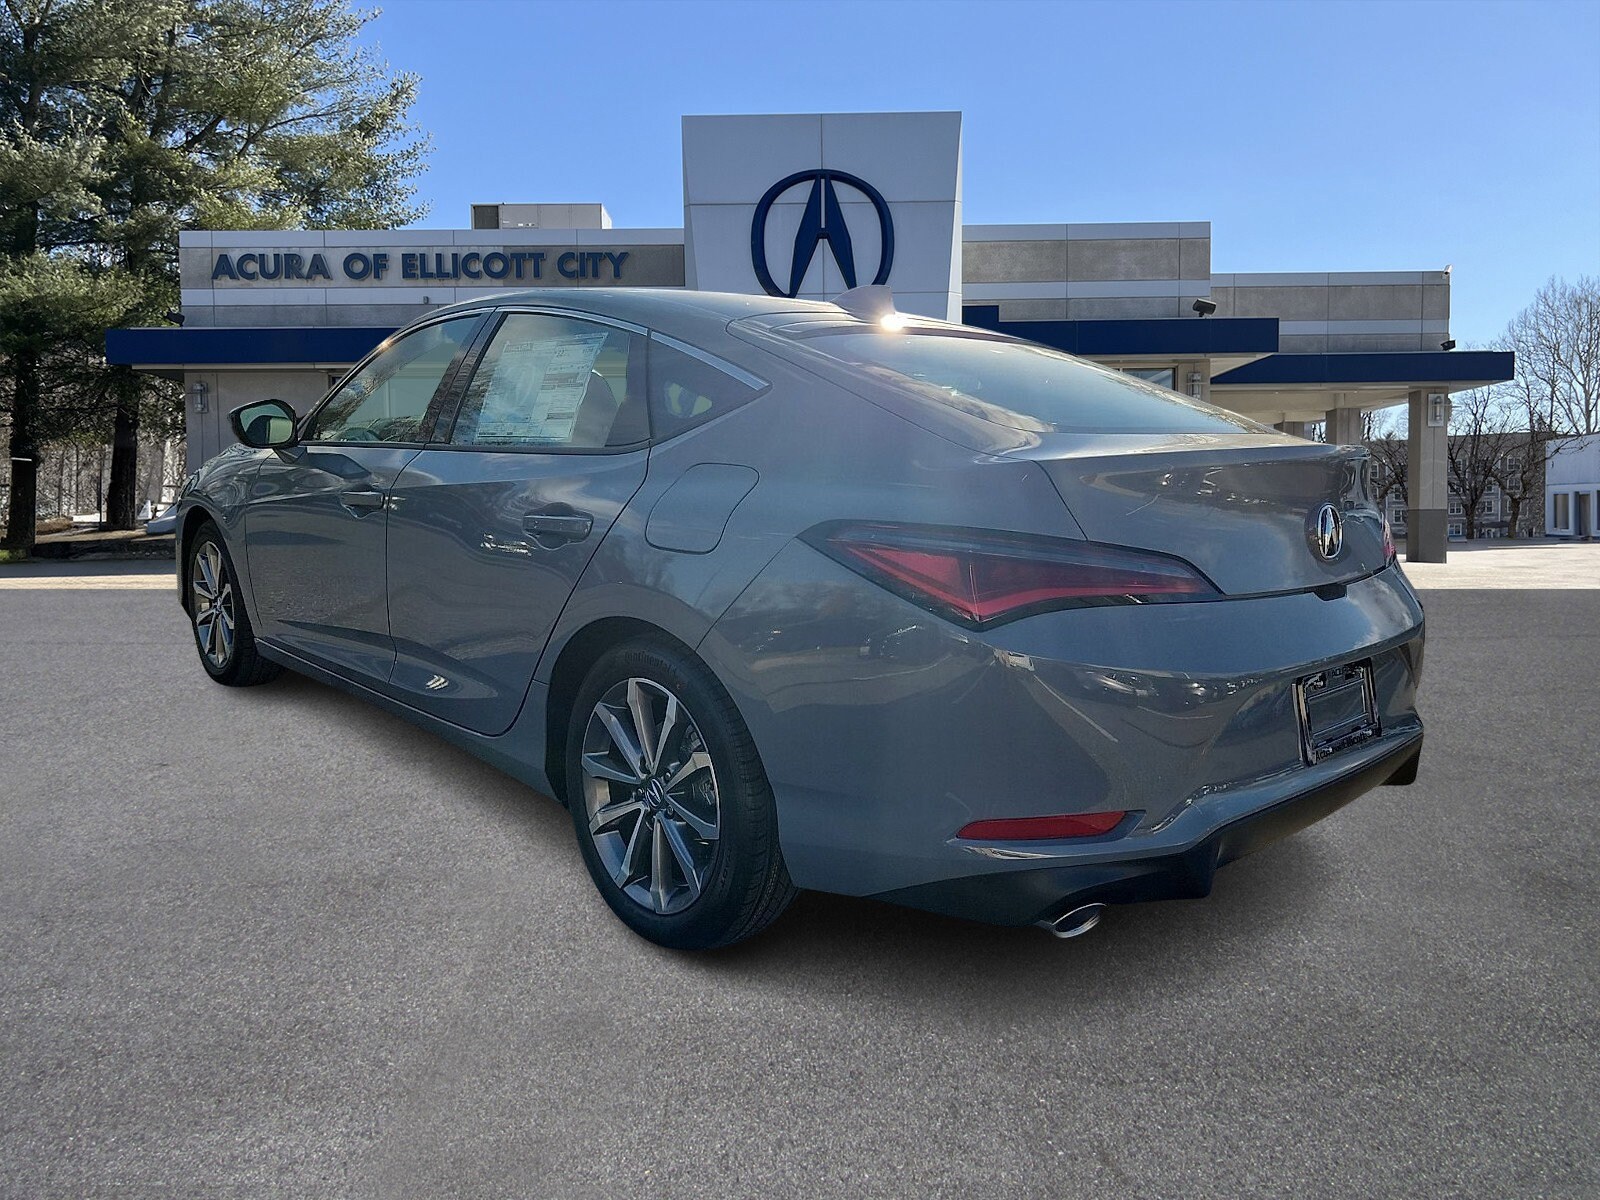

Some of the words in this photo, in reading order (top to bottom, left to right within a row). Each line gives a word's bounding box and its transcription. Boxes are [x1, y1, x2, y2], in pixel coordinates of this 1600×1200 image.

[211, 253, 331, 281] ACURA
[343, 252, 389, 280] OF
[401, 251, 546, 281] ELLICOTT
[556, 250, 629, 280] CITY
